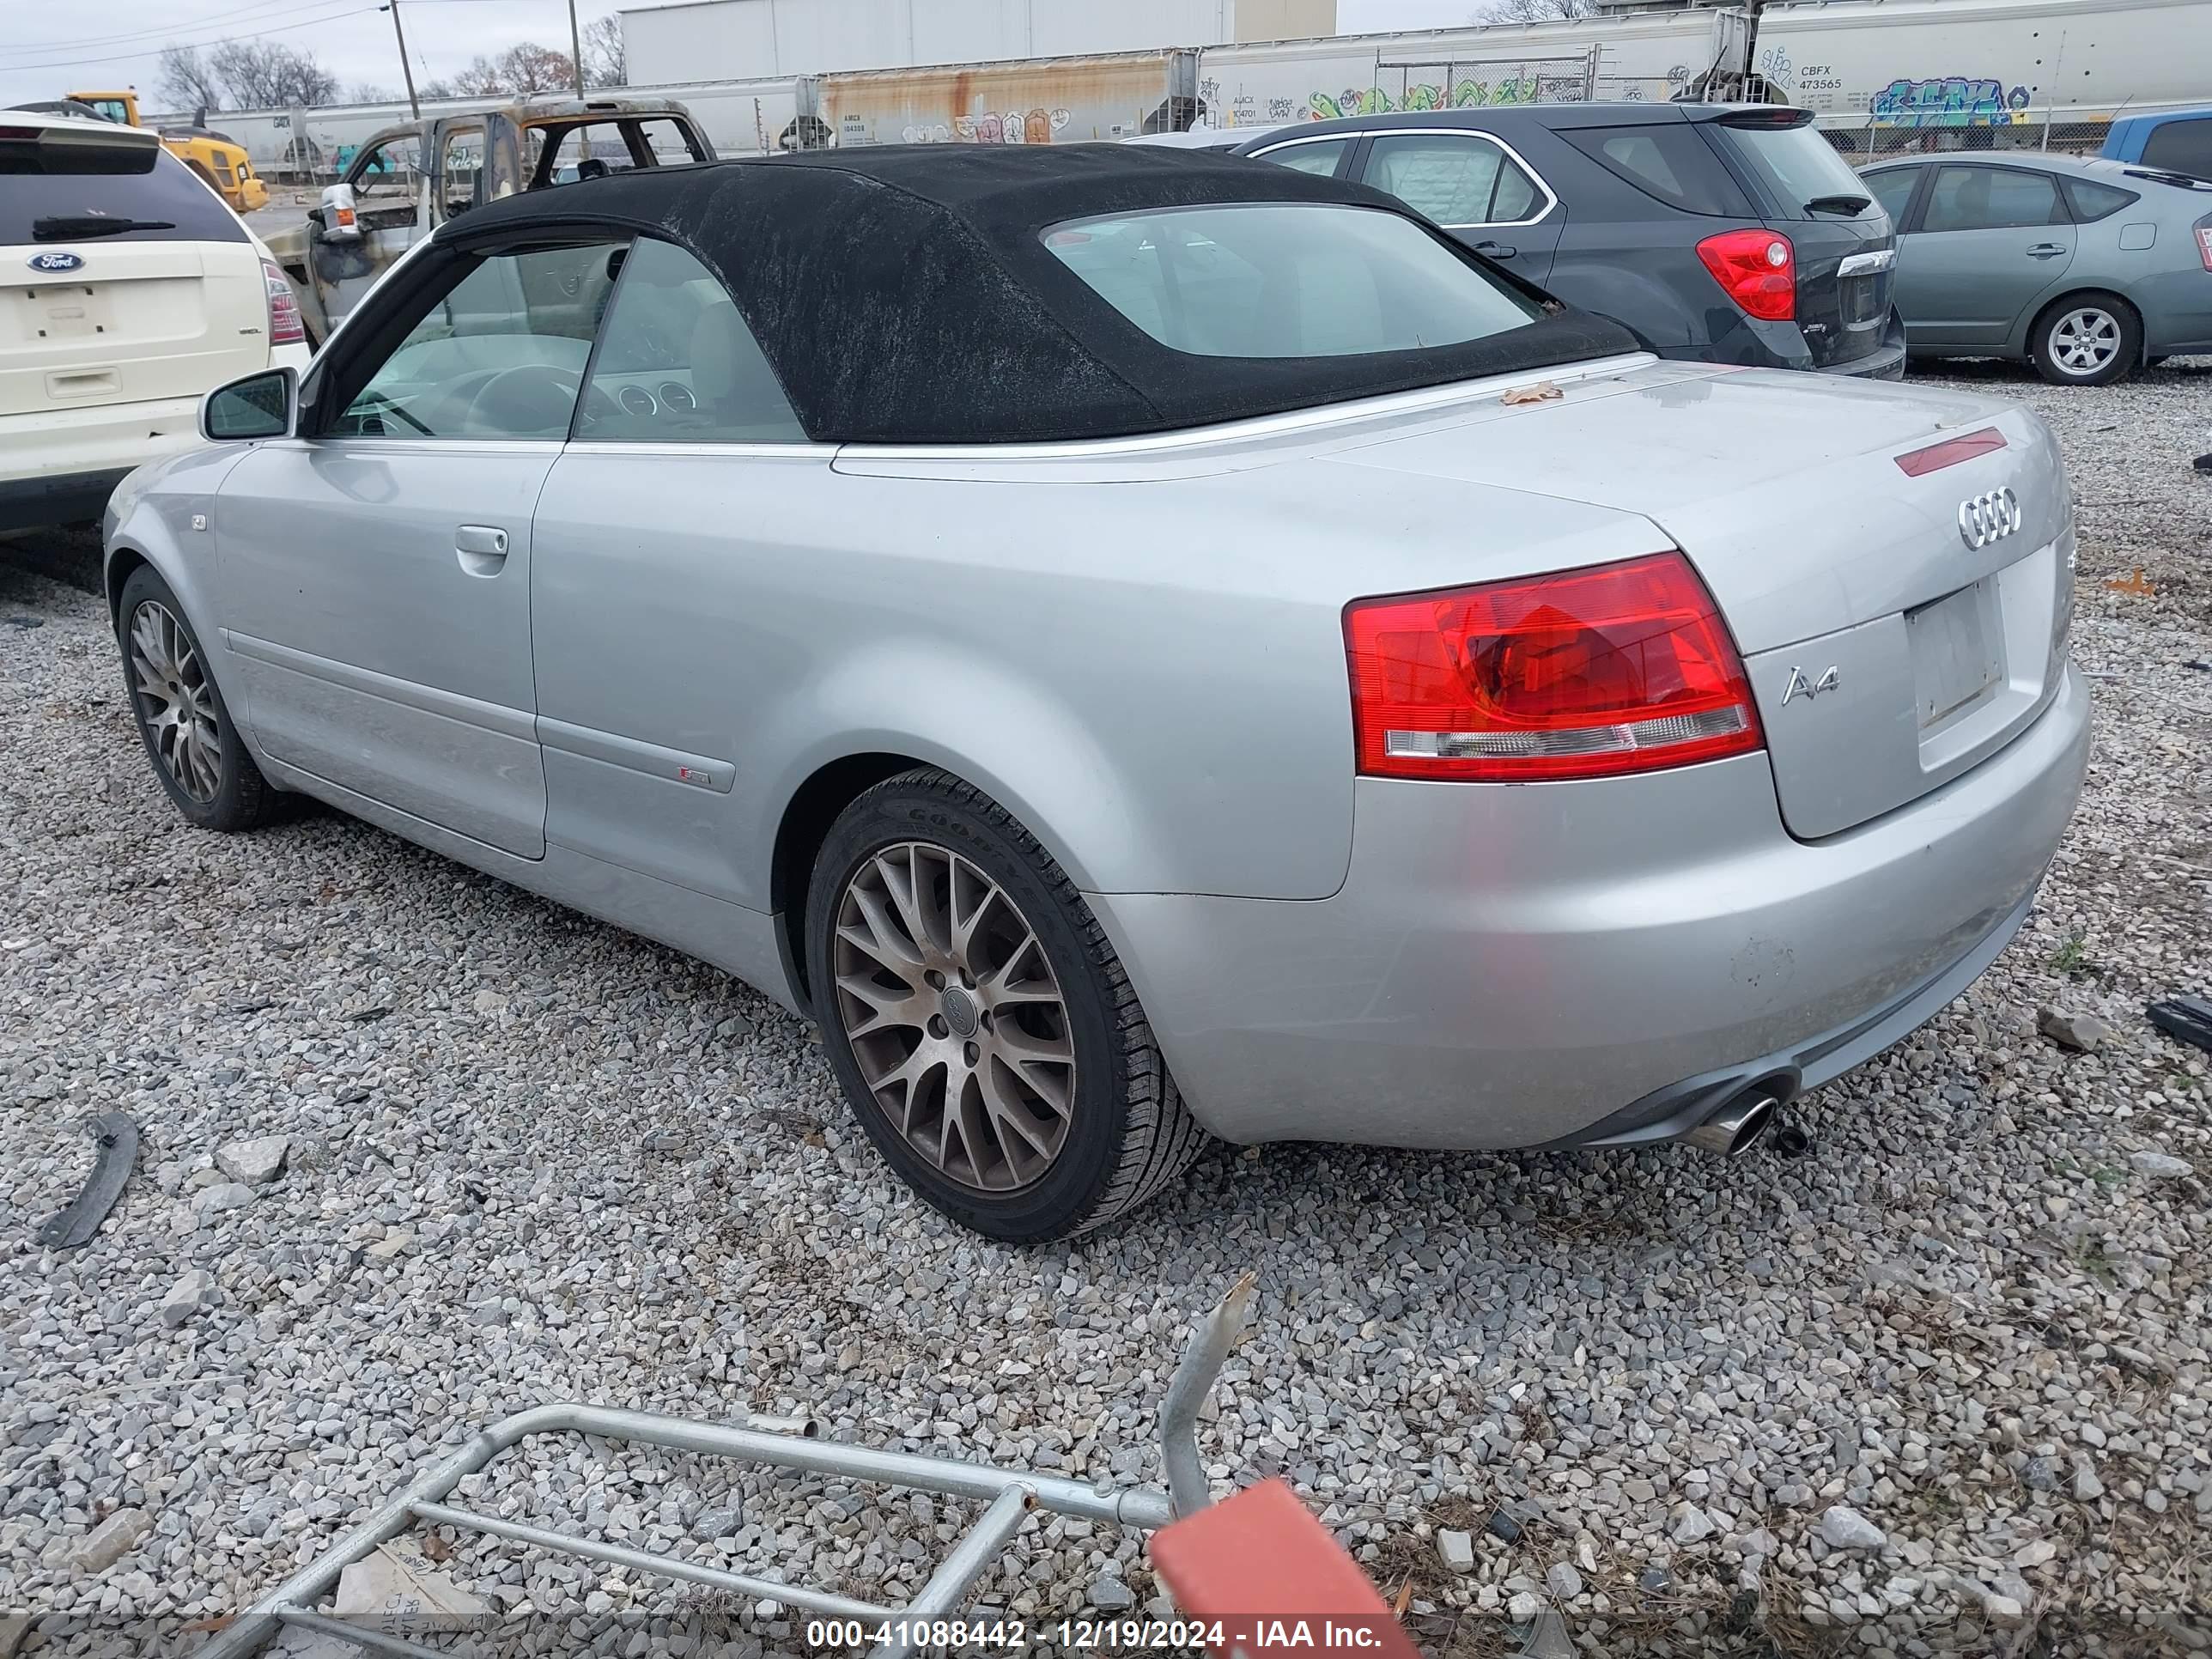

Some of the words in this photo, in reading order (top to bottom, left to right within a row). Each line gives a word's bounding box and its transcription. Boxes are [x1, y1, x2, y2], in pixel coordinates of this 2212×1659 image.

[1801, 65, 1832, 76] CBFX
[1799, 79, 1843, 89] 473565
[41, 254, 74, 269] Ford
[1782, 665, 1841, 708] A4
